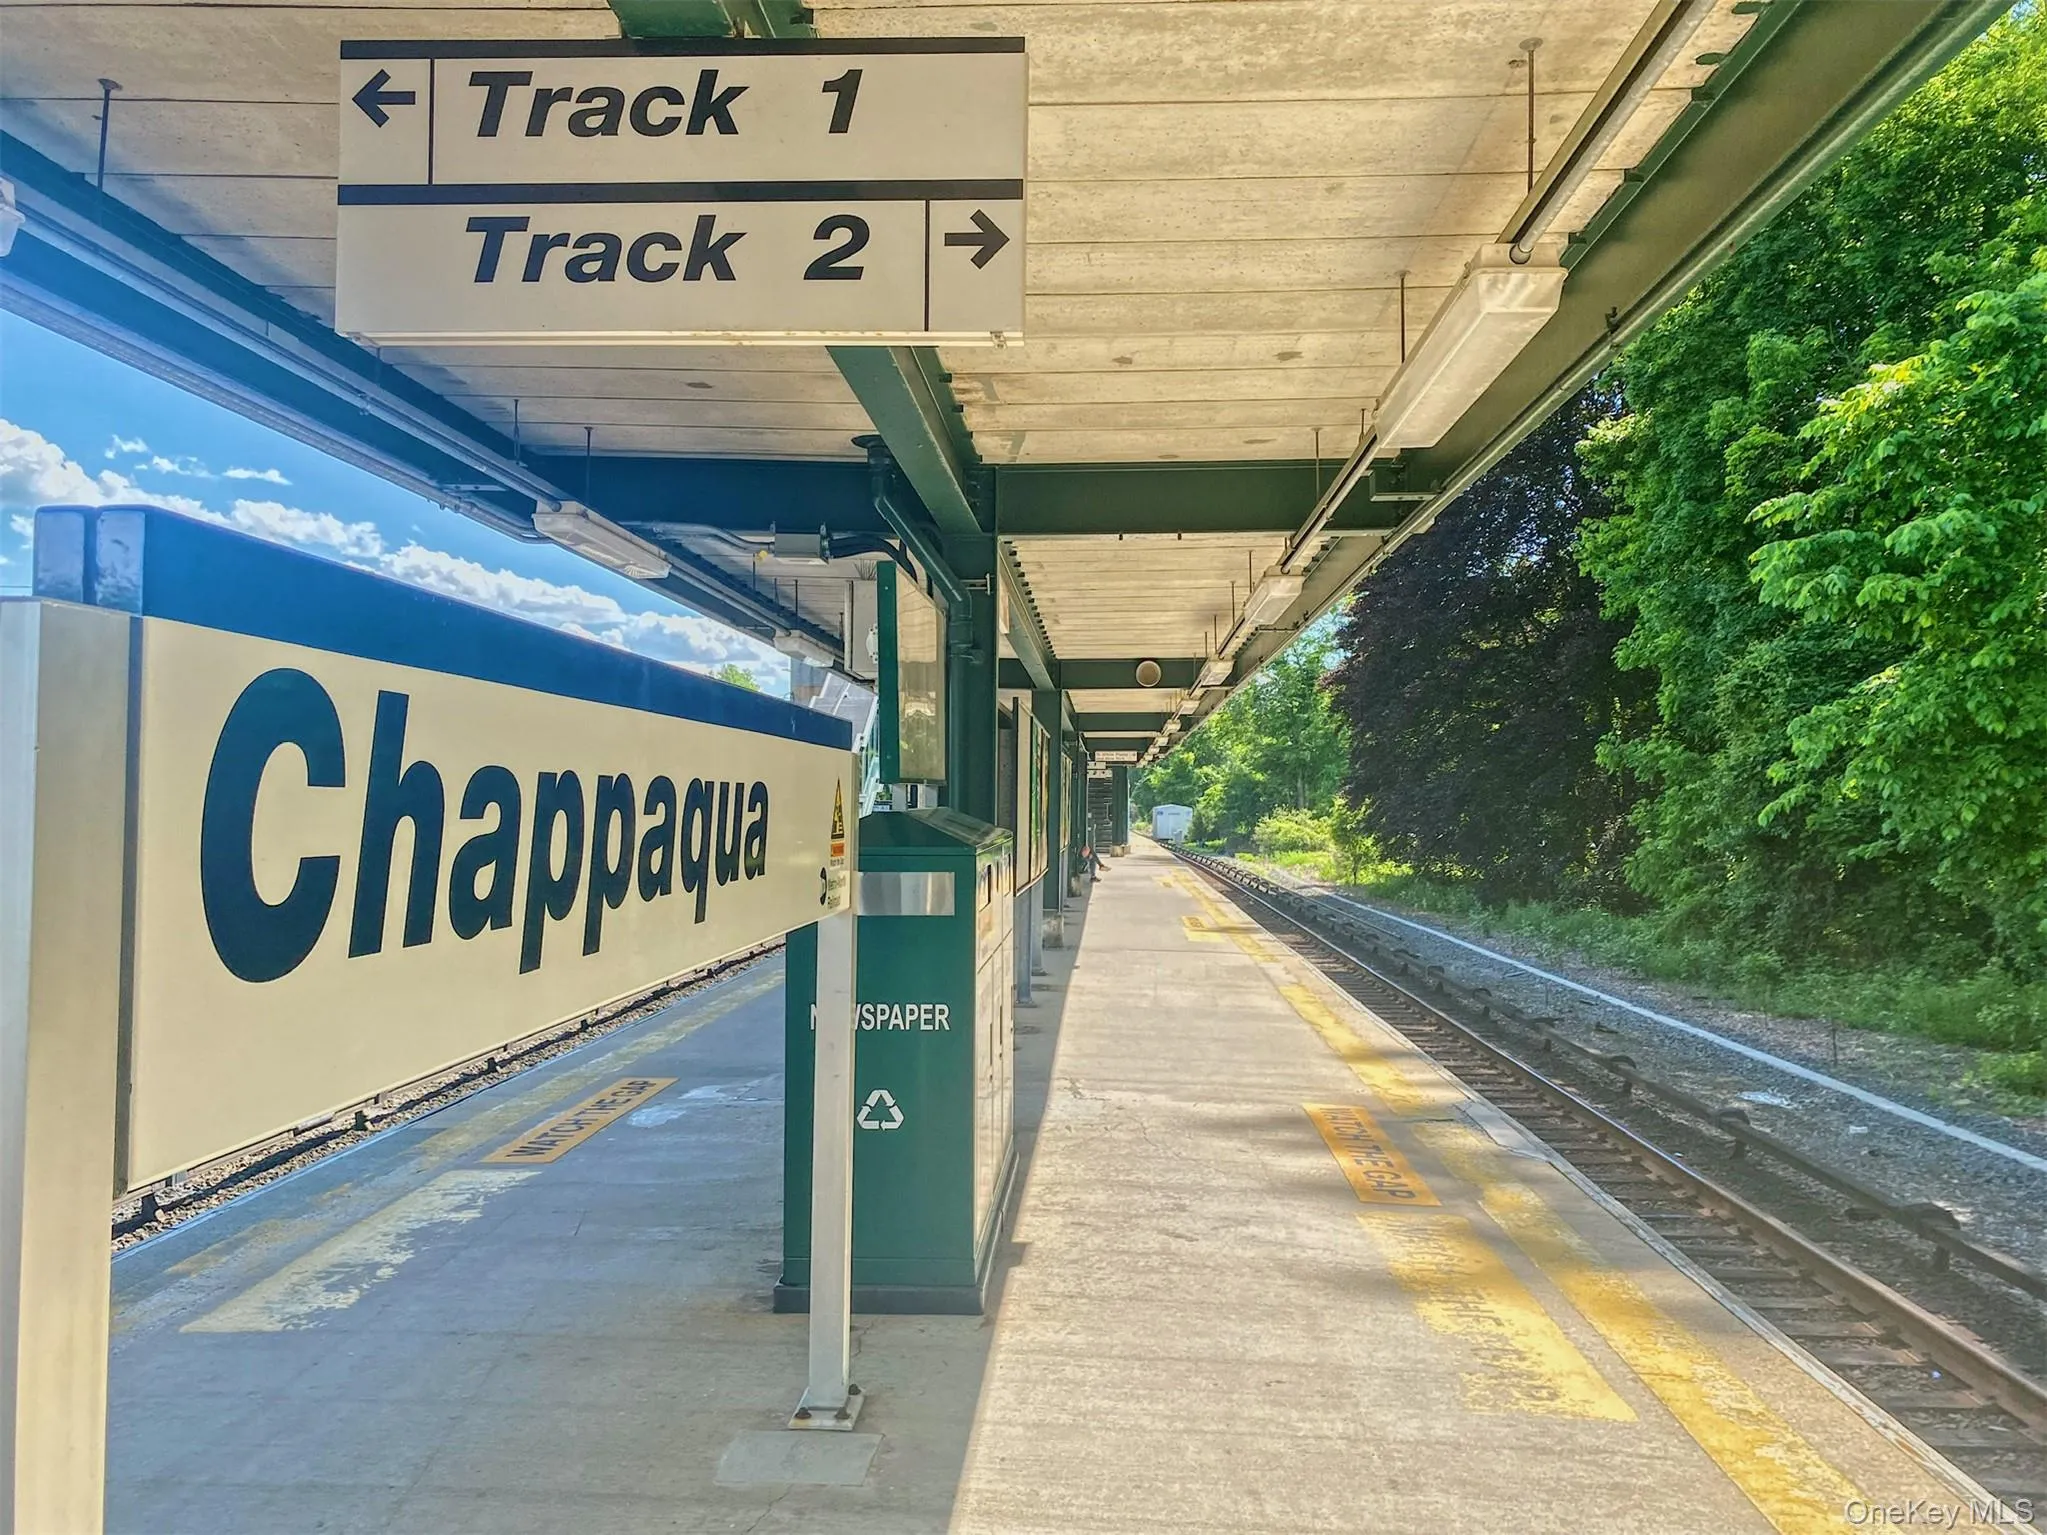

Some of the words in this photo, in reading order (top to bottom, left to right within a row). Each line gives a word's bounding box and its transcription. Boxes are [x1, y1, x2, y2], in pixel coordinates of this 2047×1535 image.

[469, 69, 749, 137] Track
[821, 69, 862, 134] 1
[465, 215, 747, 283] Track
[803, 214, 870, 280] 2
[201, 668, 768, 982] Chappaqua
[811, 1004, 950, 1030] SPAPER
[506, 1118, 599, 1157] WATCH
[574, 1099, 631, 1115] THE
[1320, 1108, 1375, 1141] WATCH
[1344, 1145, 1393, 1168] THE
[1362, 1170, 1416, 1198] GAP
